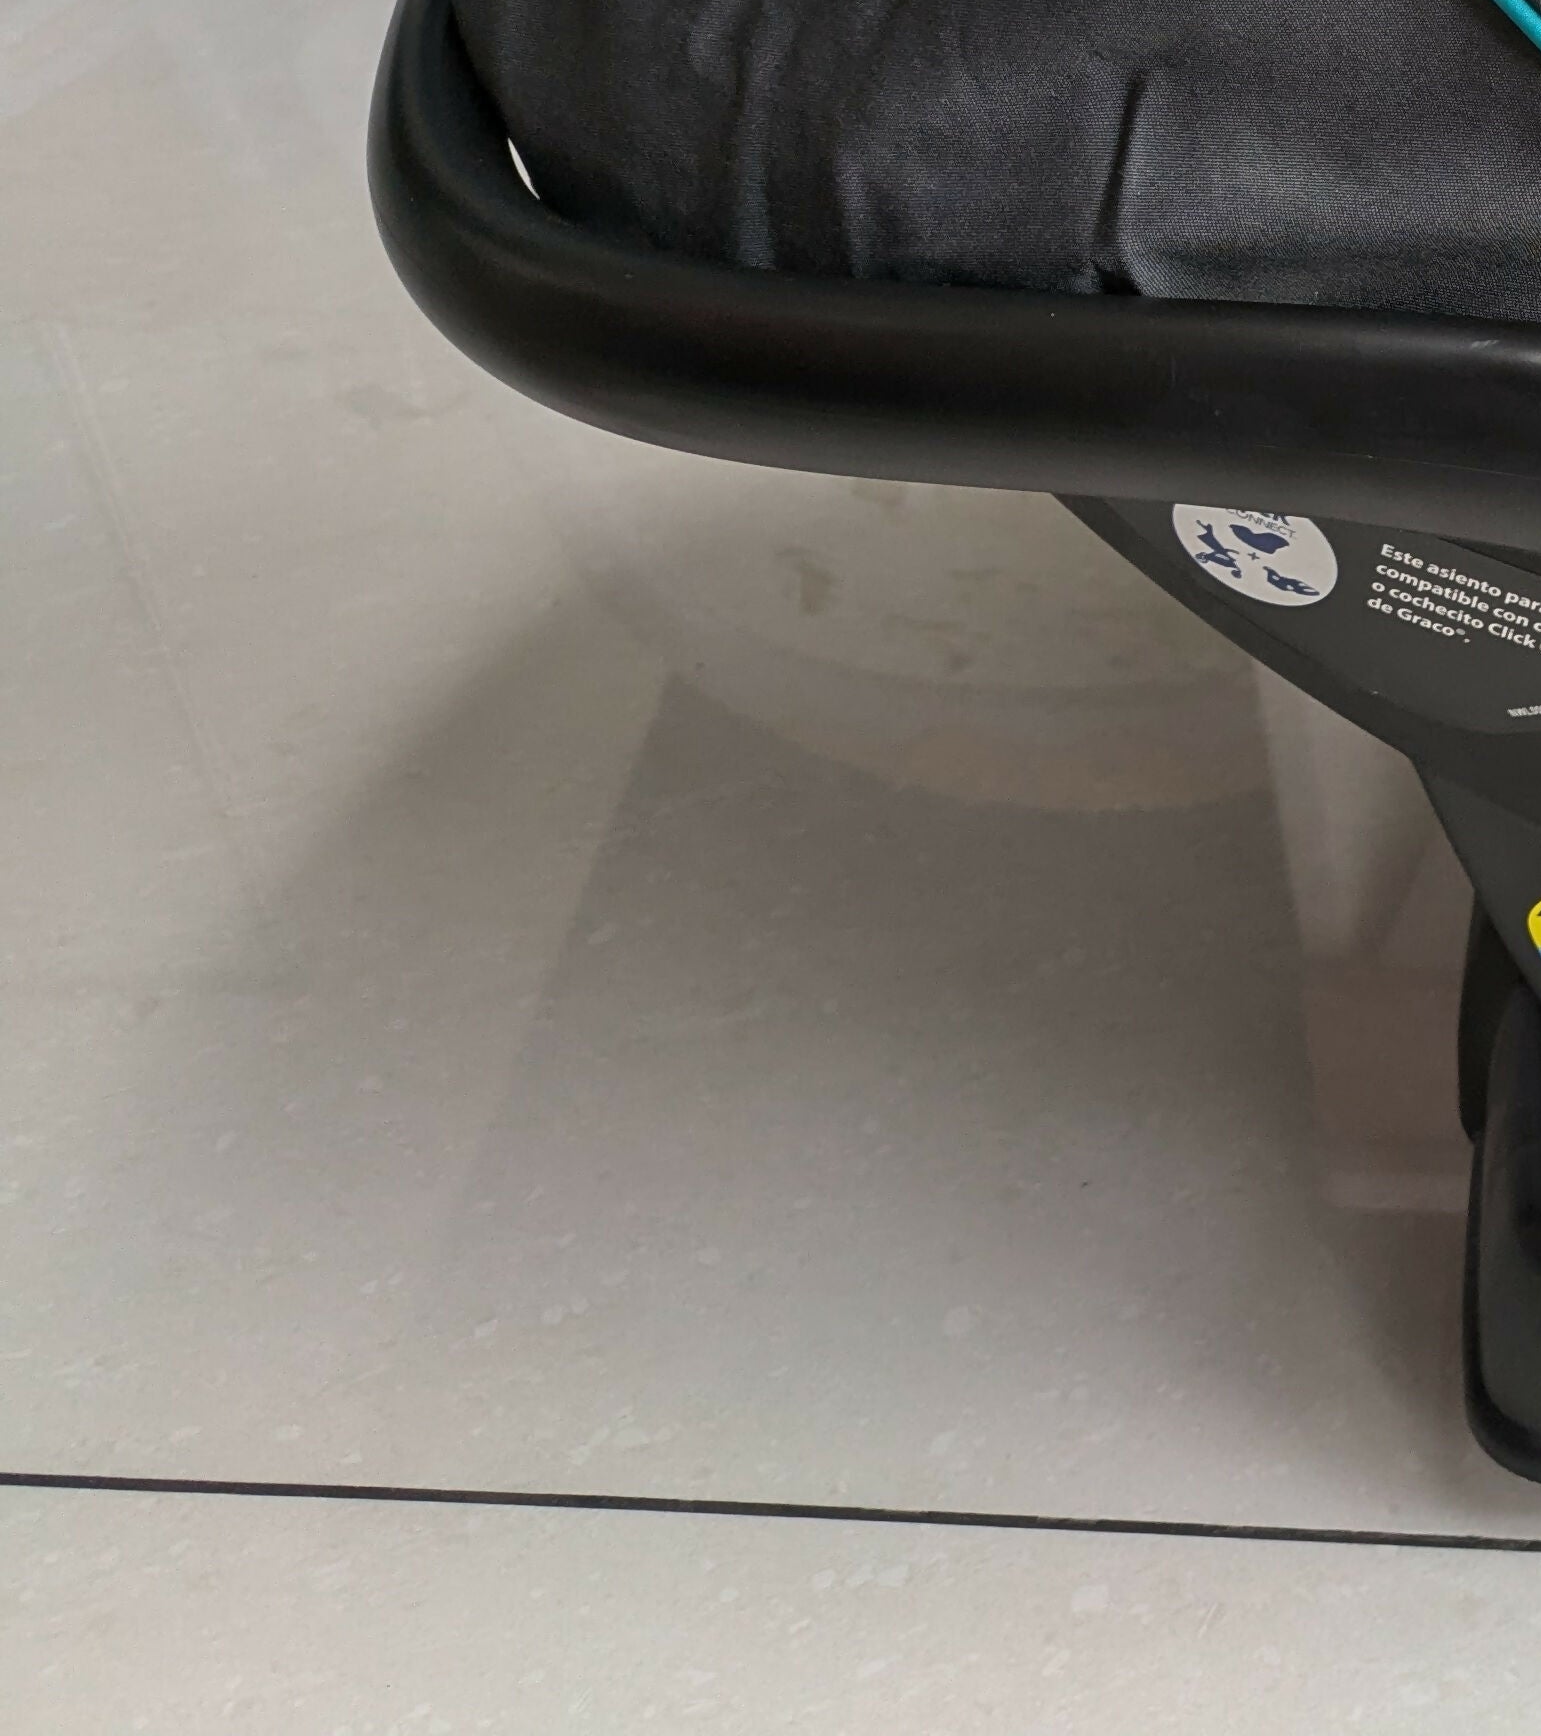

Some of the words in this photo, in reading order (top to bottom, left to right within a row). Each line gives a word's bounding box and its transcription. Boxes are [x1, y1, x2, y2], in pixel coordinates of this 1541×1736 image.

[1376, 564, 1490, 612] compatible
[1493, 608, 1529, 627] con
[1380, 544, 1424, 568] Este
[1427, 563, 1501, 597] asiento
[1367, 598, 1394, 614] de
[1371, 581, 1386, 592] o
[1388, 587, 1484, 630] cochecito
[1488, 623, 1536, 650] Click
